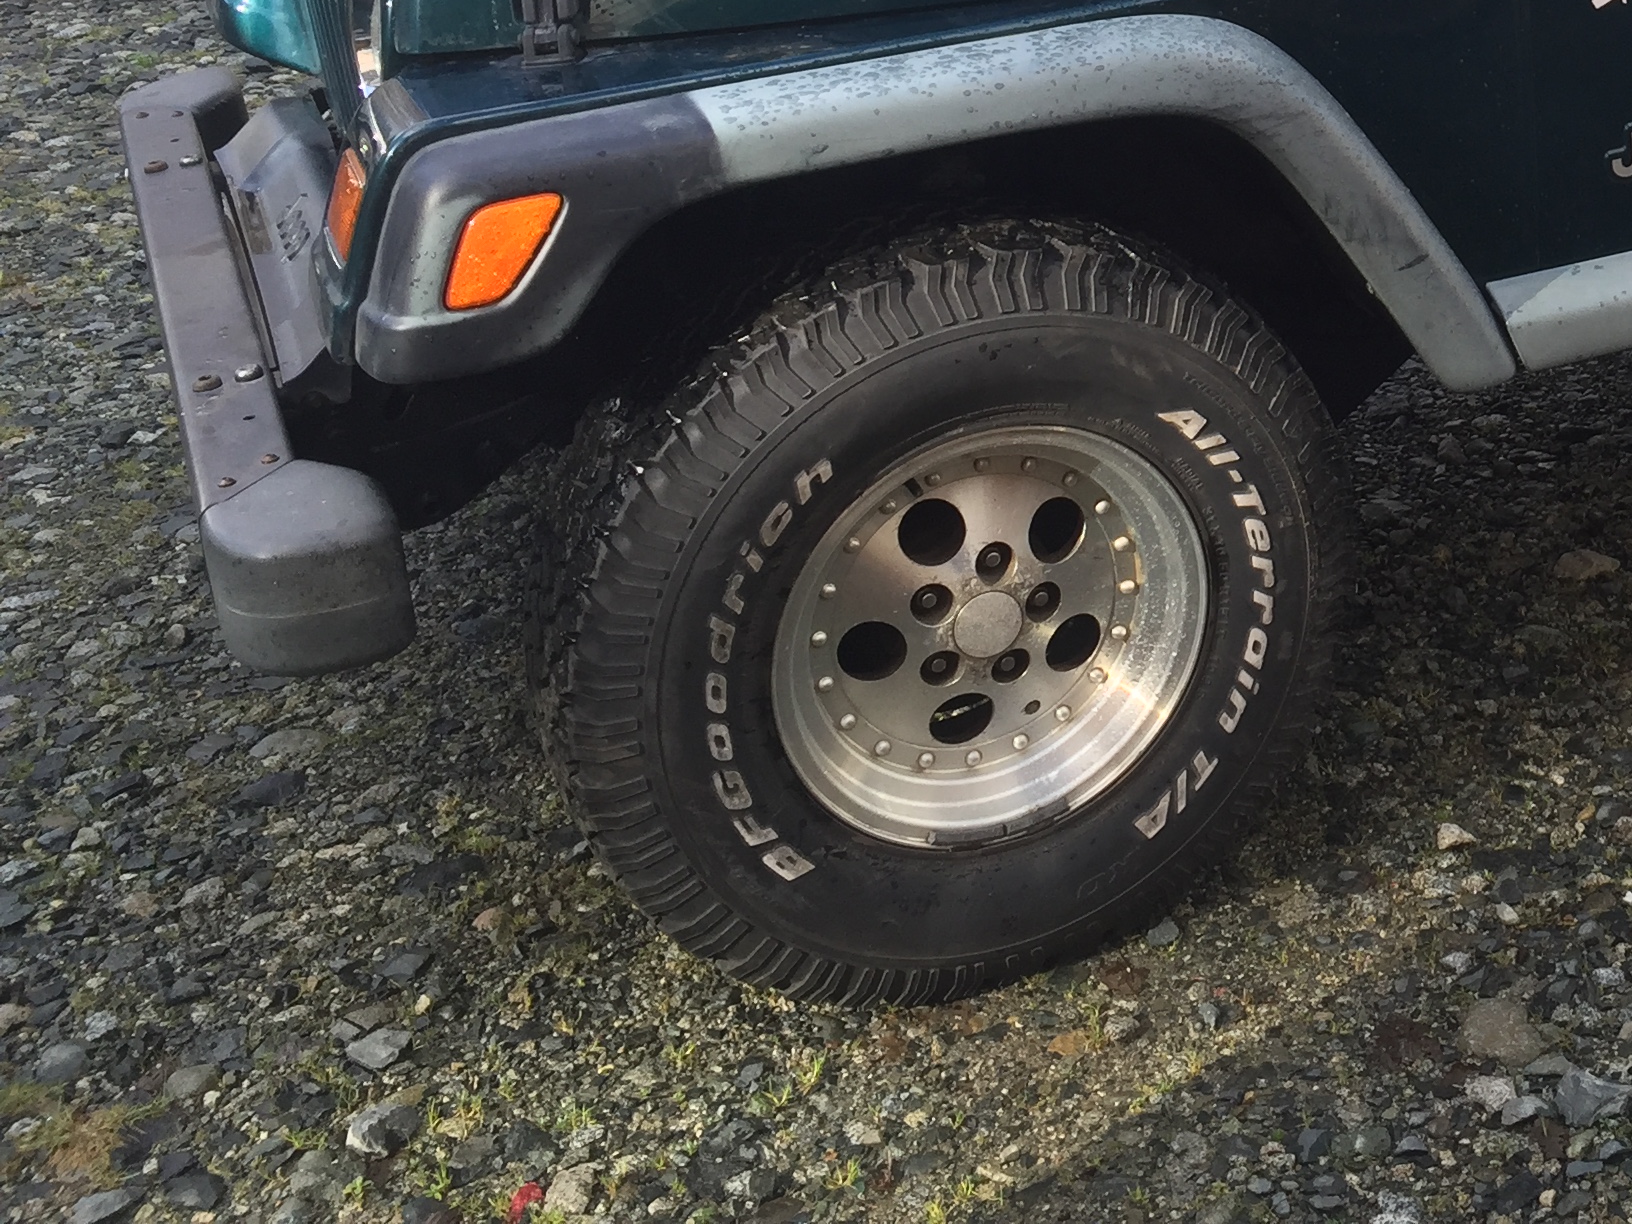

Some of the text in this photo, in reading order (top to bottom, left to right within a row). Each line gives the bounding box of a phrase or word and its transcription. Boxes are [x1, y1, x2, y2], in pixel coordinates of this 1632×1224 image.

[704, 456, 834, 882] BFGoodrich
[1156, 407, 1276, 734] All-Terrain
[1133, 749, 1220, 840] T/A
